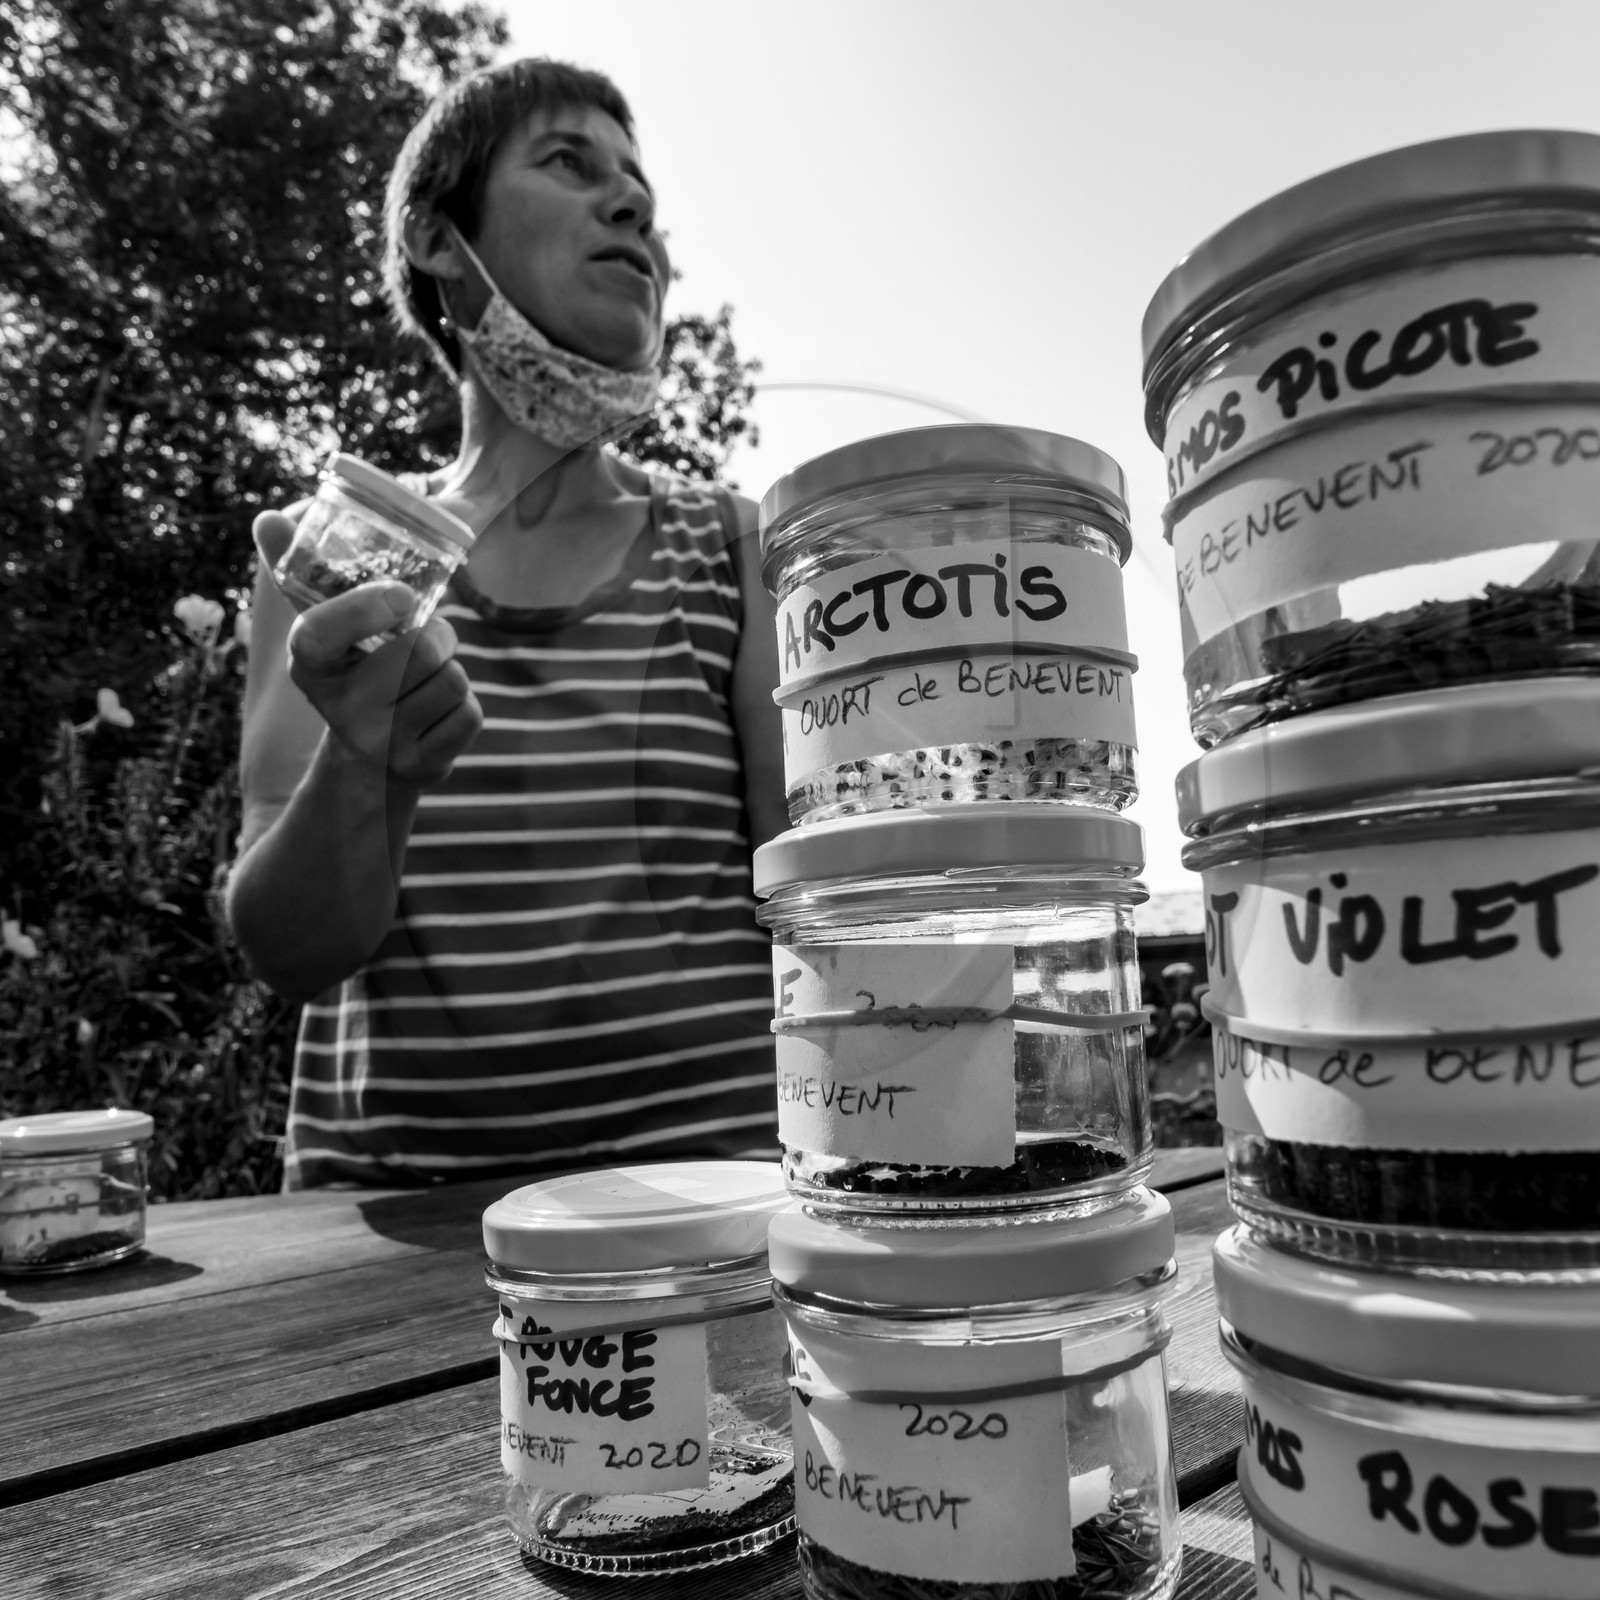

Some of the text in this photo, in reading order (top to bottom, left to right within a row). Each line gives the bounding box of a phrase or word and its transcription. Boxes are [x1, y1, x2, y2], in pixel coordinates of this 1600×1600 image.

[1200, 439, 1435, 578] BENEVENT
[1469, 427, 1600, 476] 2020
[897, 671, 942, 707] de
[957, 659, 1124, 704] BENEVENT
[525, 1365, 656, 1422] FONCE
[899, 1402, 1009, 1441] 2020
[598, 1437, 701, 1470] 2020
[804, 1449, 973, 1531] BENEVENT
[1358, 1449, 1600, 1557] ROSE
